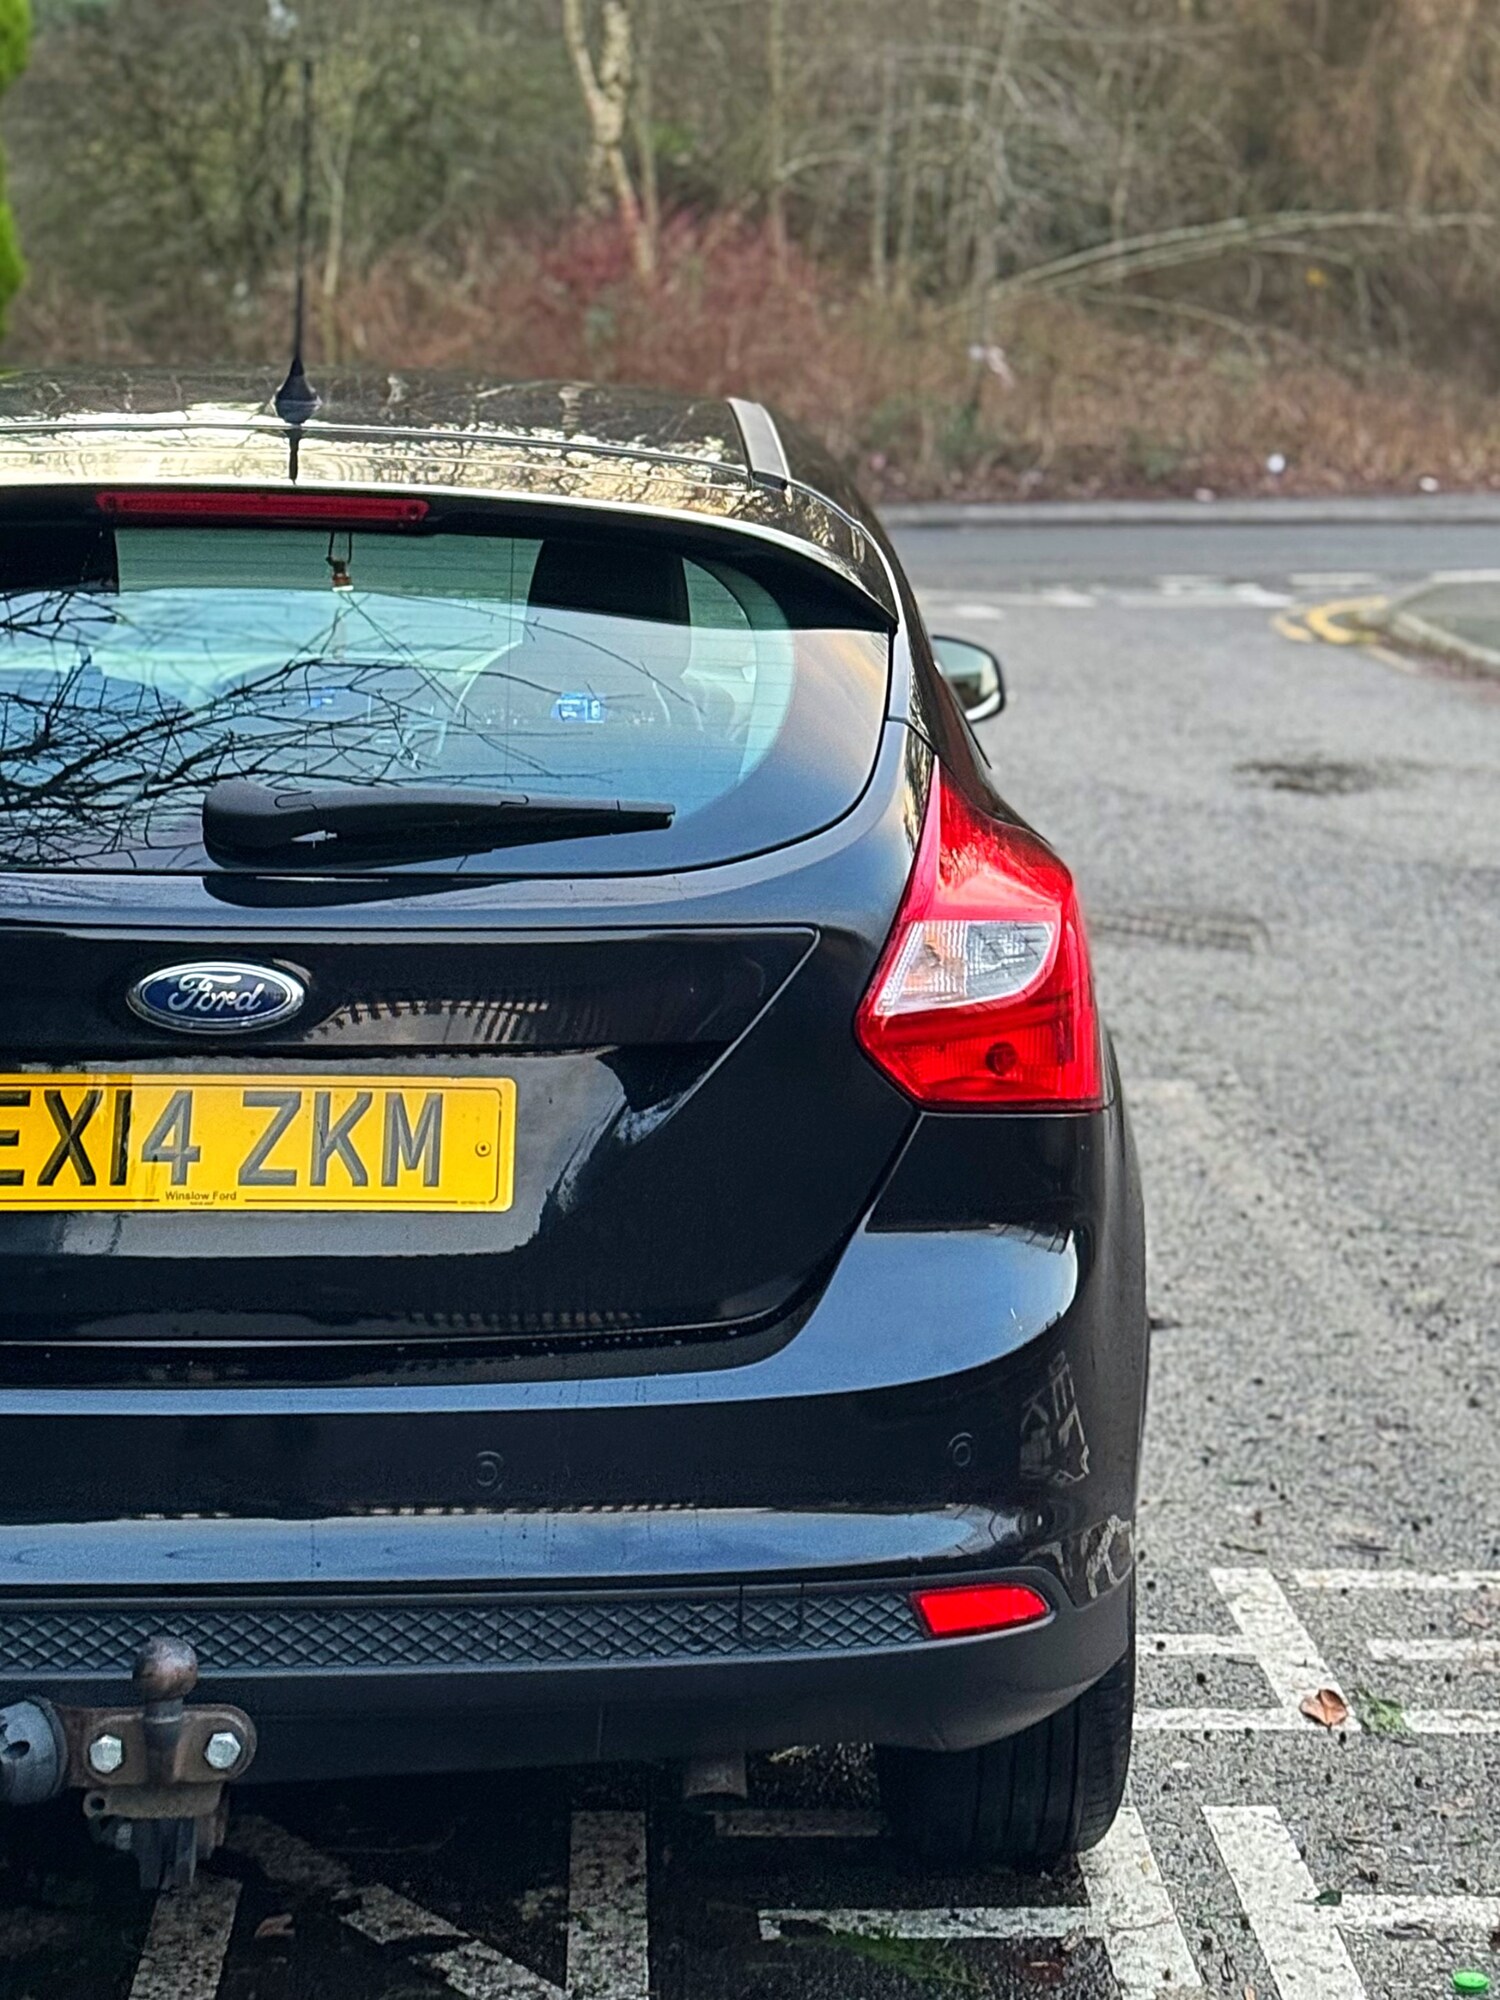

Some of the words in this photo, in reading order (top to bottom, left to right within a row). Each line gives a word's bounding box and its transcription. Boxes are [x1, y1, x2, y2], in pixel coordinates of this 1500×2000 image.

[168, 973, 265, 1012] Ford
[238, 1091, 444, 1188] ZKM
[165, 1191, 209, 1201] Winslow
[212, 1191, 237, 1201] Ford
